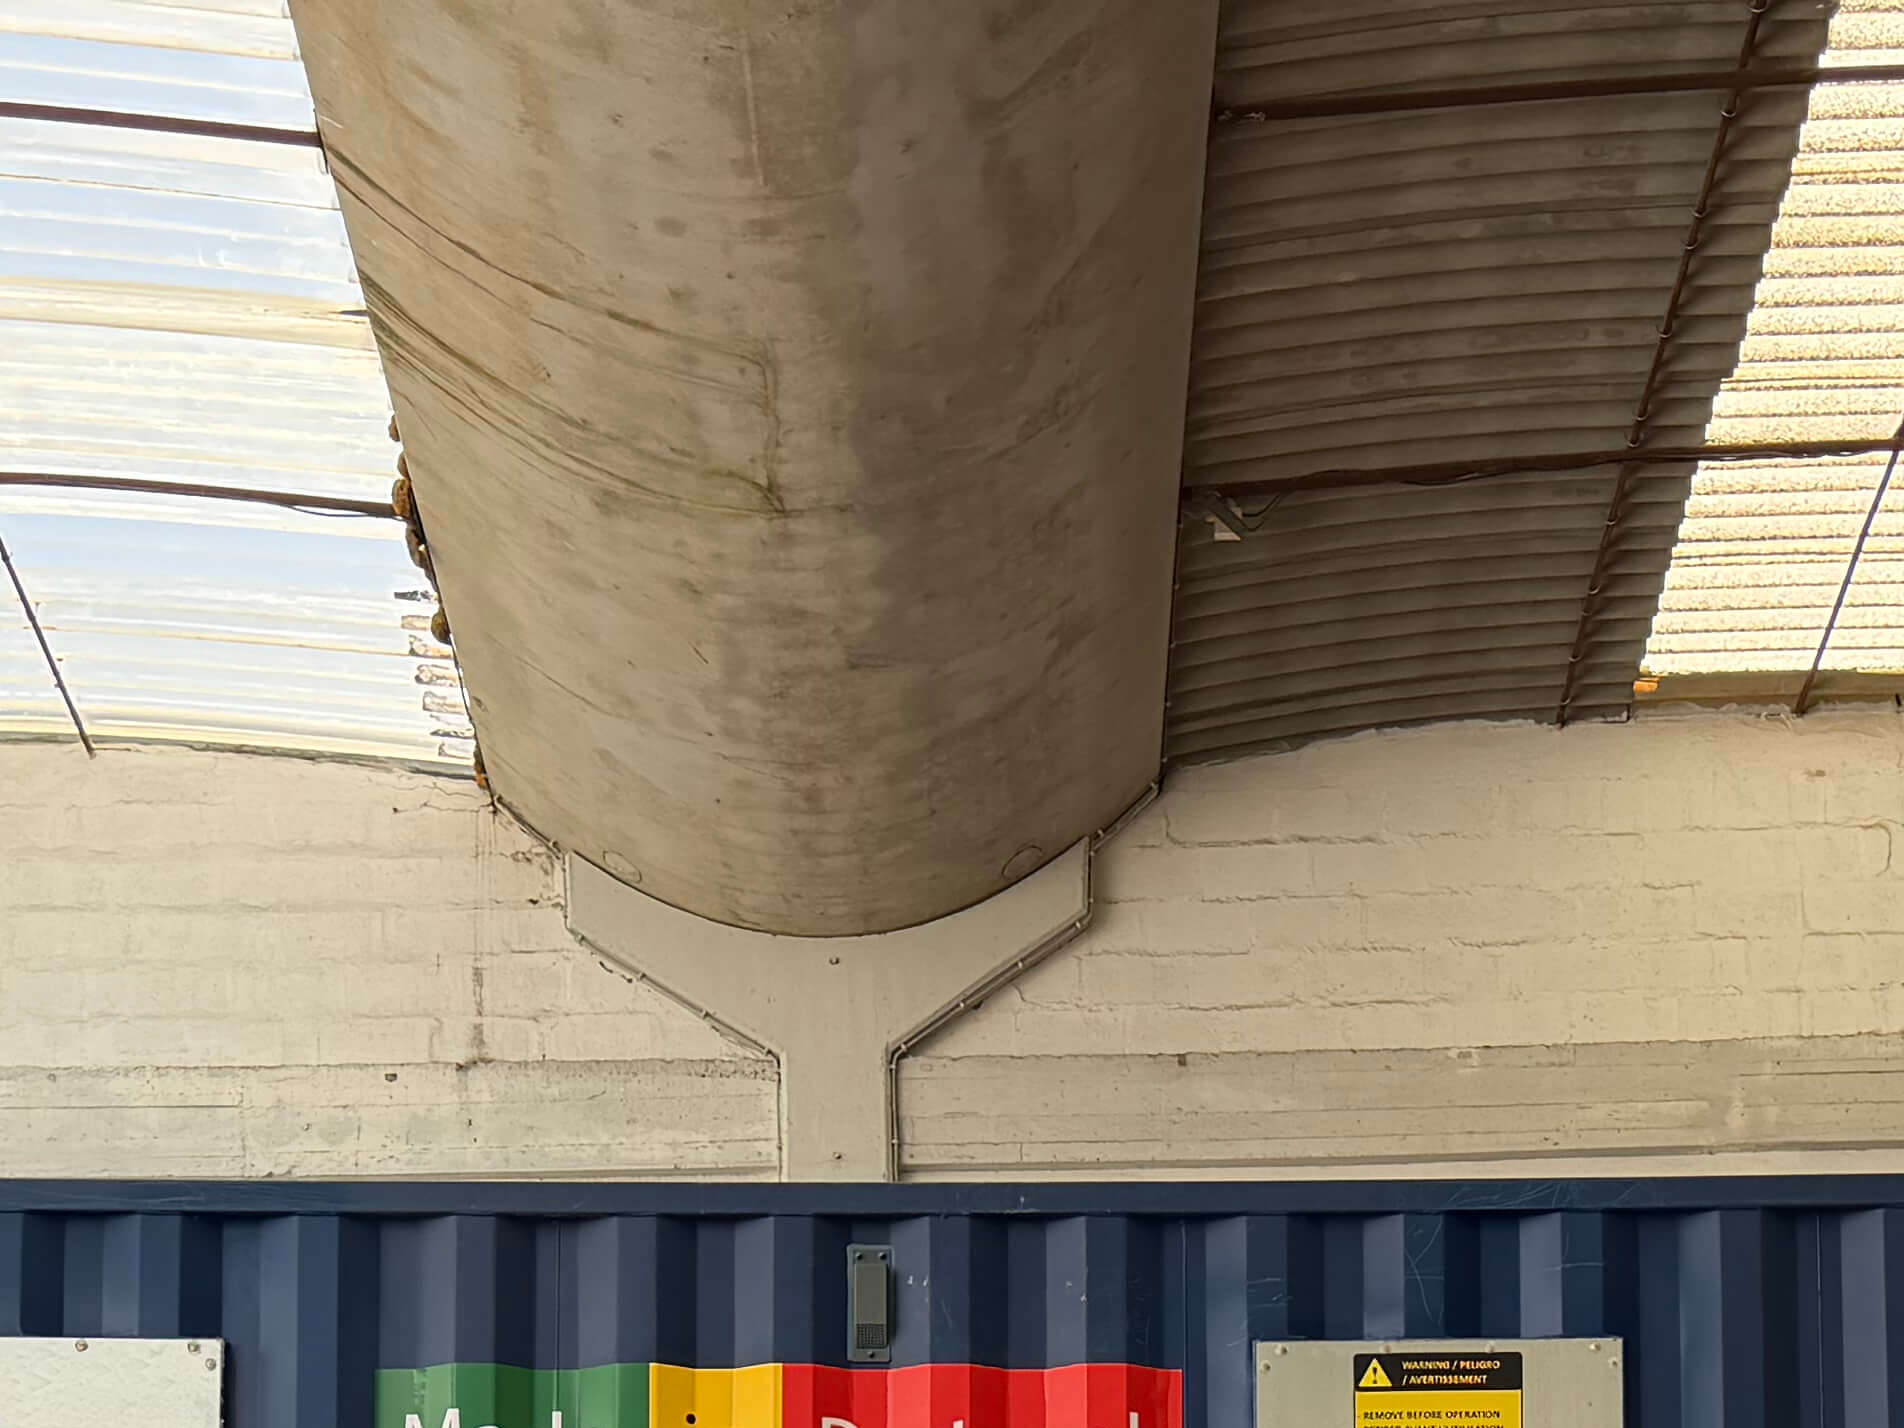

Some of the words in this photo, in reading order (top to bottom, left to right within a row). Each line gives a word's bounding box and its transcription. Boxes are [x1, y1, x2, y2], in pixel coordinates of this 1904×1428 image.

[1402, 1360, 1450, 1370] WARNING
[1460, 1360, 1501, 1370] PELIGRO
[1409, 1375, 1488, 1385] AVERTISSEMENT
[1363, 1411, 1403, 1420] REMOVE
[1406, 1411, 1442, 1419] BEFORE
[1445, 1410, 1501, 1419] OPERATION
